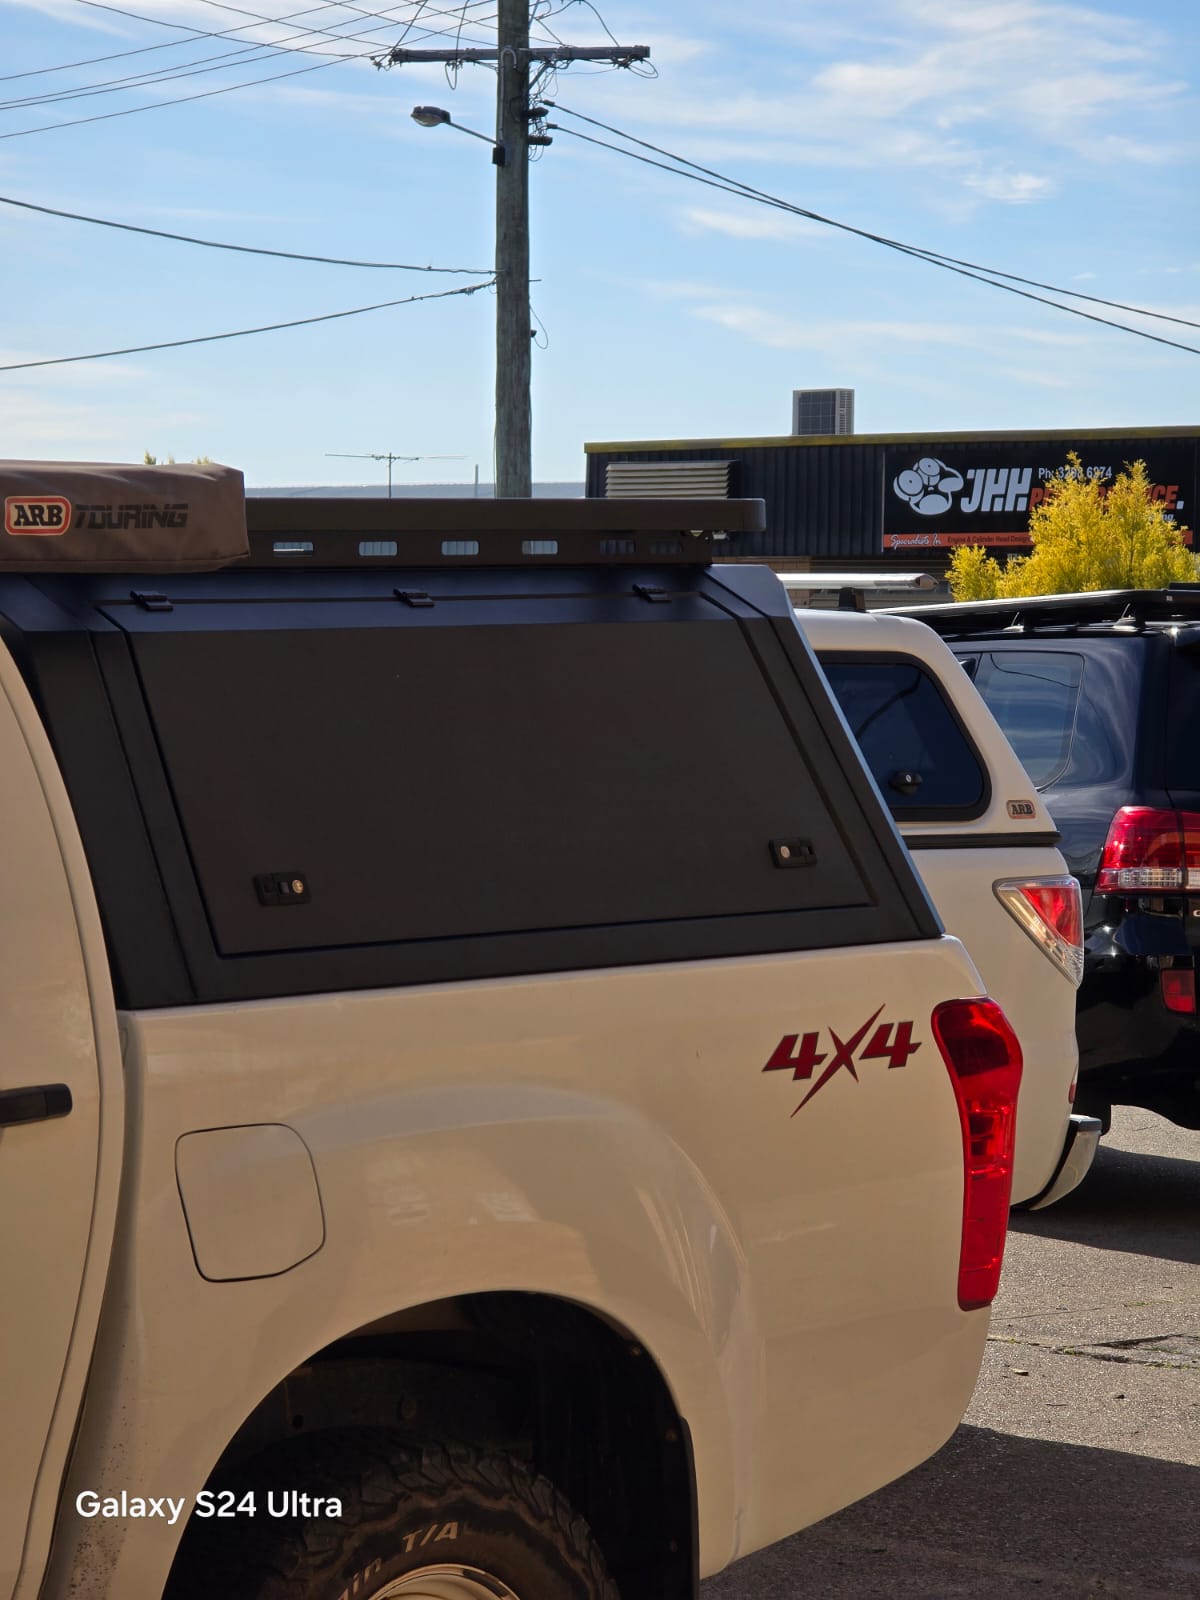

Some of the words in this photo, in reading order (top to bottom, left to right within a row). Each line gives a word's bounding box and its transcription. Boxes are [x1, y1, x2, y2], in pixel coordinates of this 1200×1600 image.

[960, 467, 1033, 513] JHH
[13, 504, 63, 527] ARB
[74, 502, 189, 529] TOURING
[1011, 803, 1033, 815] ARB
[402, 1521, 459, 1553] T/A
